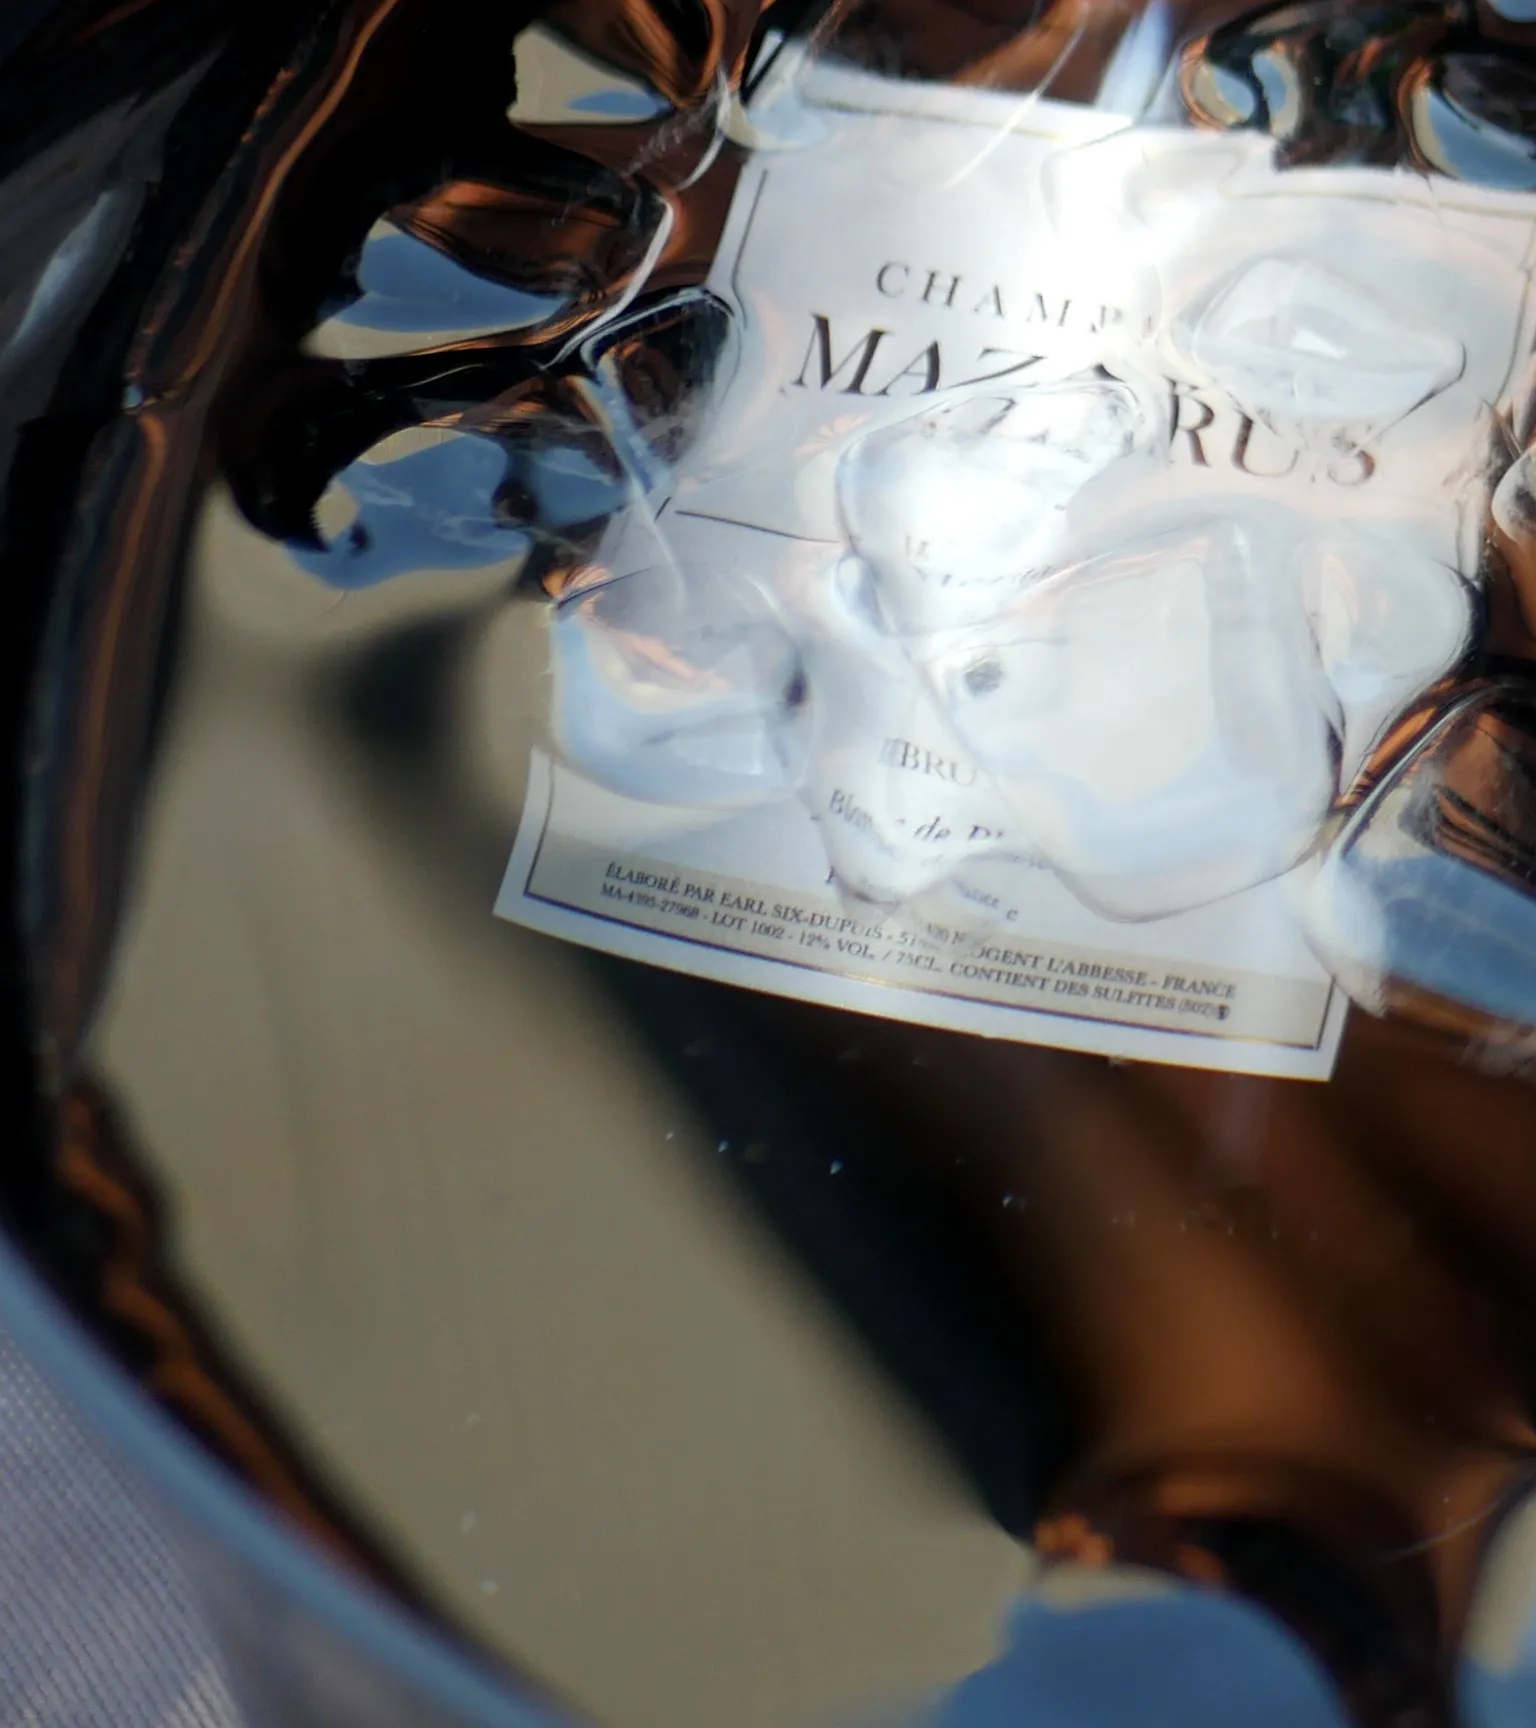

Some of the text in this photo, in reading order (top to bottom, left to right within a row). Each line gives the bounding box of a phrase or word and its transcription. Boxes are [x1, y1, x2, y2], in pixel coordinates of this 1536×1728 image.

[788, 312, 1378, 486] MAZRUS
[899, 738, 978, 787] BRU
[605, 860, 680, 894] ÉLABORÉ
[683, 882, 716, 904] PAR
[719, 892, 768, 917] EARL
[1046, 957, 1148, 987] L'ABBESSE
[1162, 974, 1237, 999] FRANCE
[711, 911, 748, 932] LOT
[950, 961, 1050, 991] CONTIENT
[1052, 978, 1088, 997] DES
[1092, 985, 1177, 1010] SULFITES
